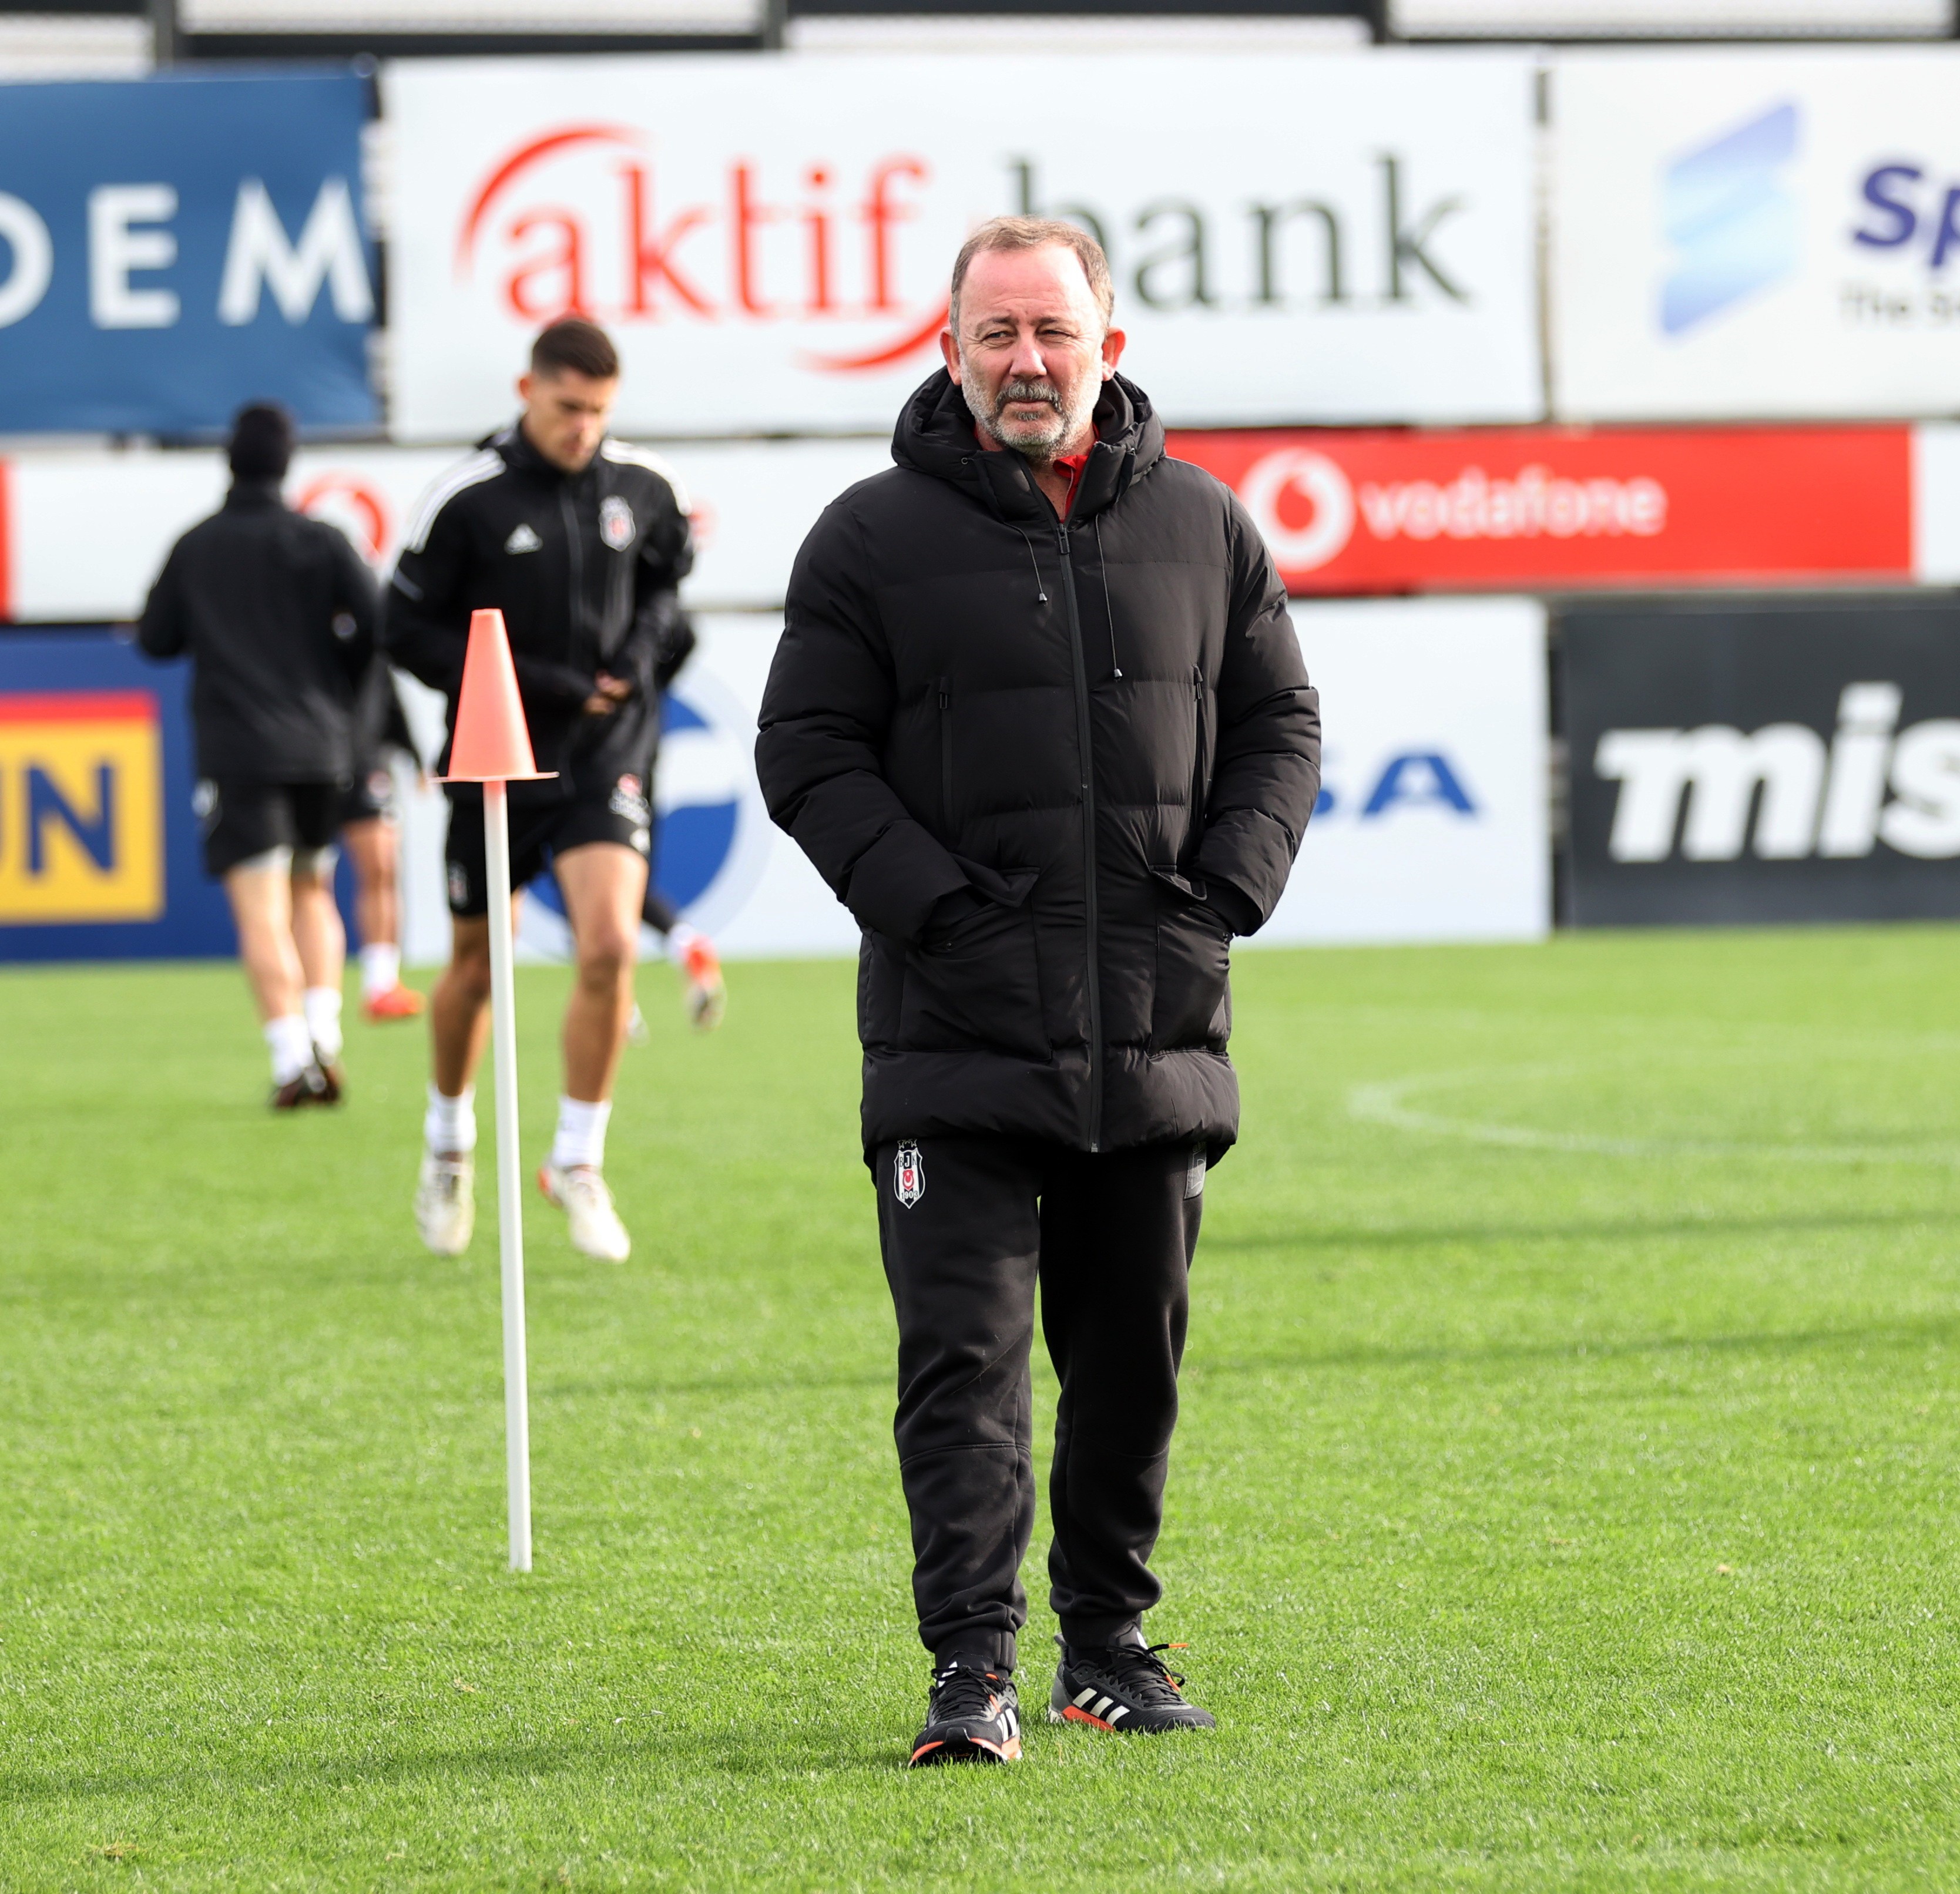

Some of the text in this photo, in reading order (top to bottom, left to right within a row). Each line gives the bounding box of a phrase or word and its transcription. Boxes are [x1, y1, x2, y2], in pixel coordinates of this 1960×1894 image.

[501, 154, 929, 322] aktif
[1360, 464, 1667, 539] vodafone
[1311, 747, 1478, 819] A
[899, 1154, 918, 1168] BJK
[901, 1190, 918, 1200] 1903
